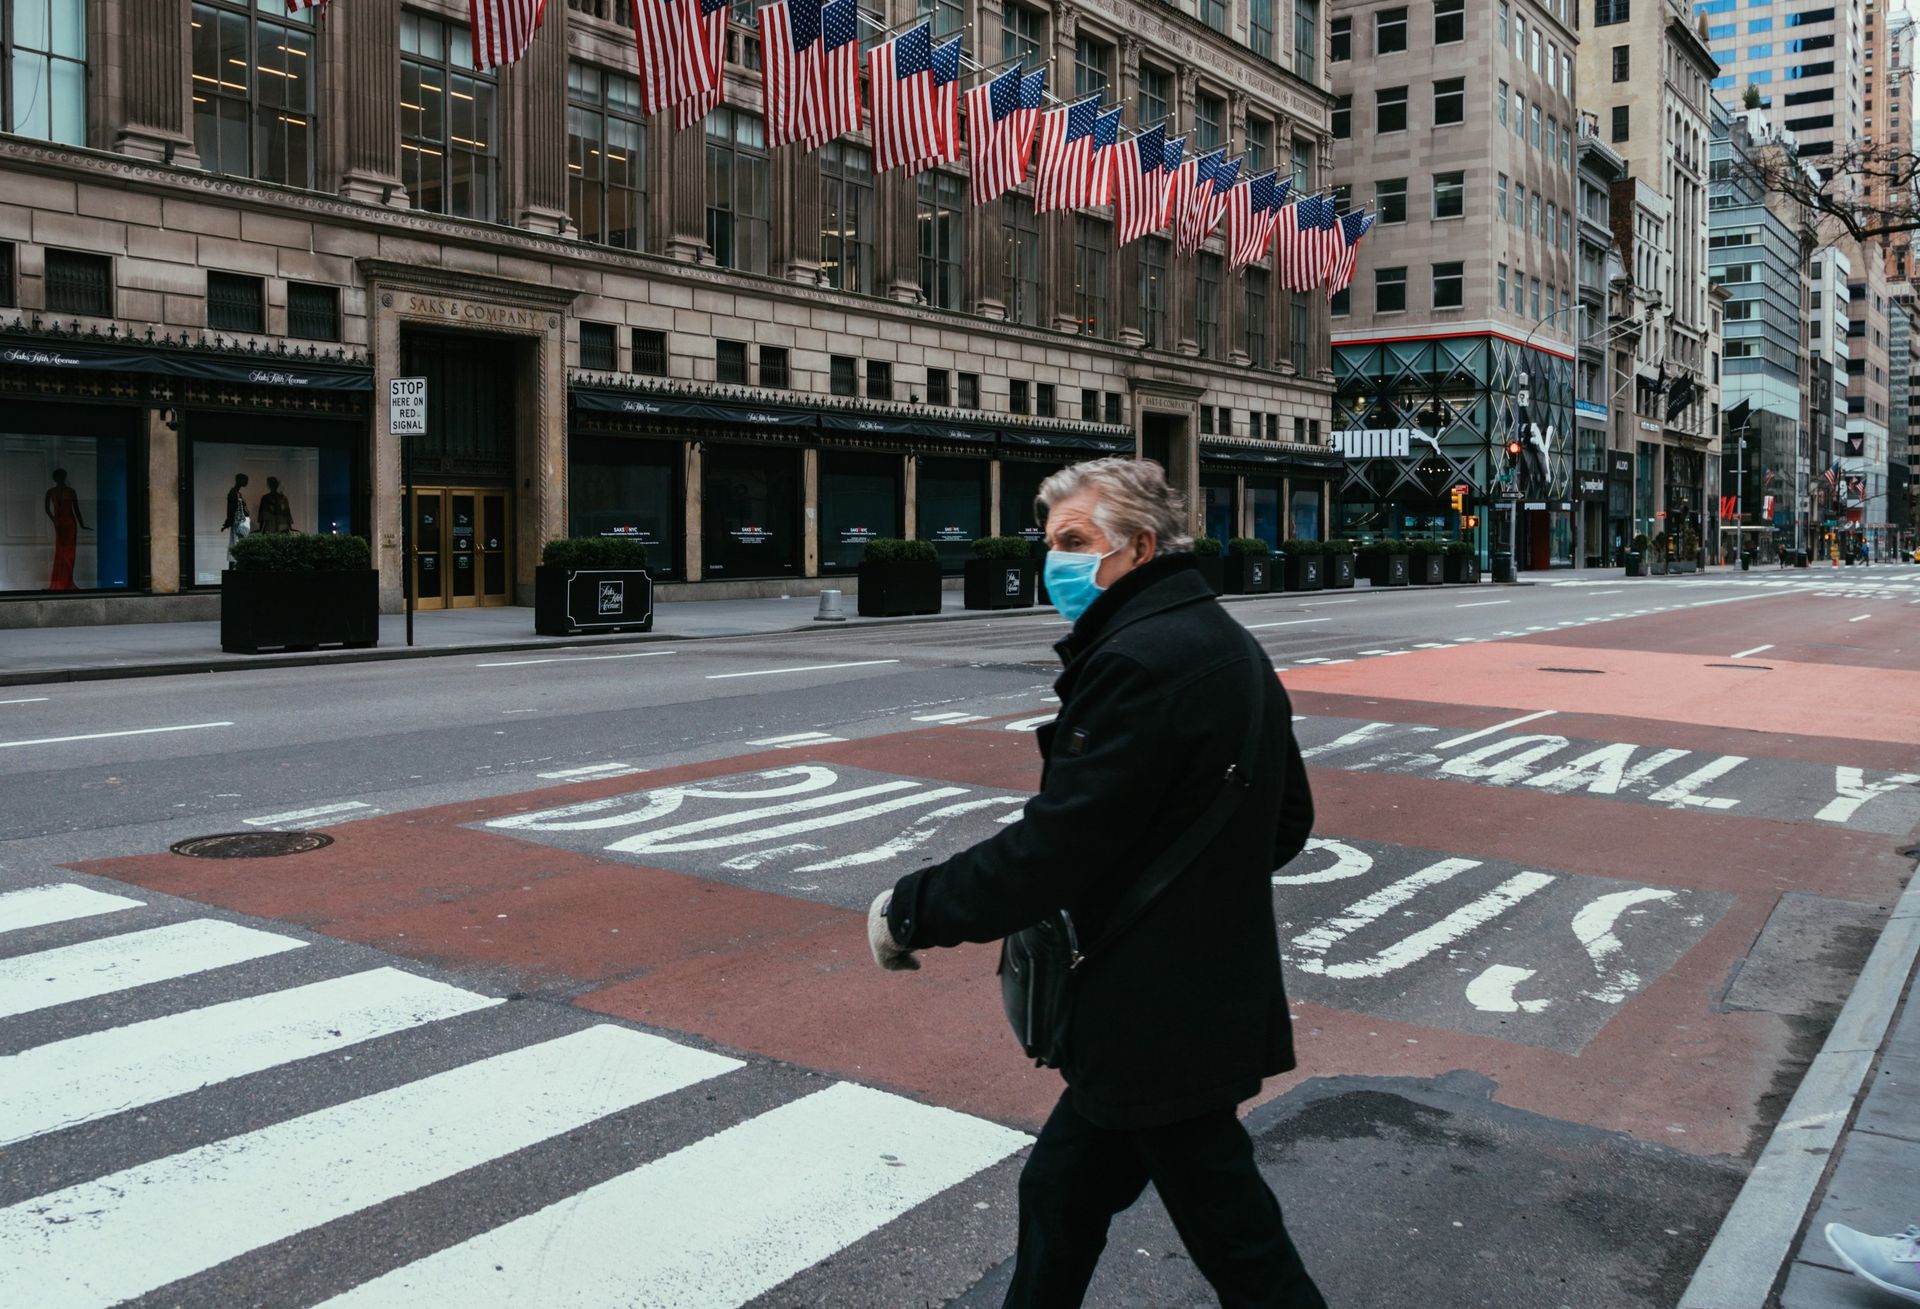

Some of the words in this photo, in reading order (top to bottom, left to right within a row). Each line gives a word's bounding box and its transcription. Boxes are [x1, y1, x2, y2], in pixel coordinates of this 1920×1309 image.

[409, 296, 445, 315] SAKS
[450, 302, 458, 316] &
[464, 304, 538, 326] COMPANY
[4, 349, 30, 361] Saks
[392, 381, 424, 395] STOP
[392, 397, 411, 407] HERE
[413, 397, 424, 406] ON
[399, 409, 417, 418] RED
[392, 420, 423, 430] SIGNAL
[1330, 428, 1409, 458] PUMA
[1616, 460, 1628, 471] ALDO
[485, 765, 1032, 880] BUS
